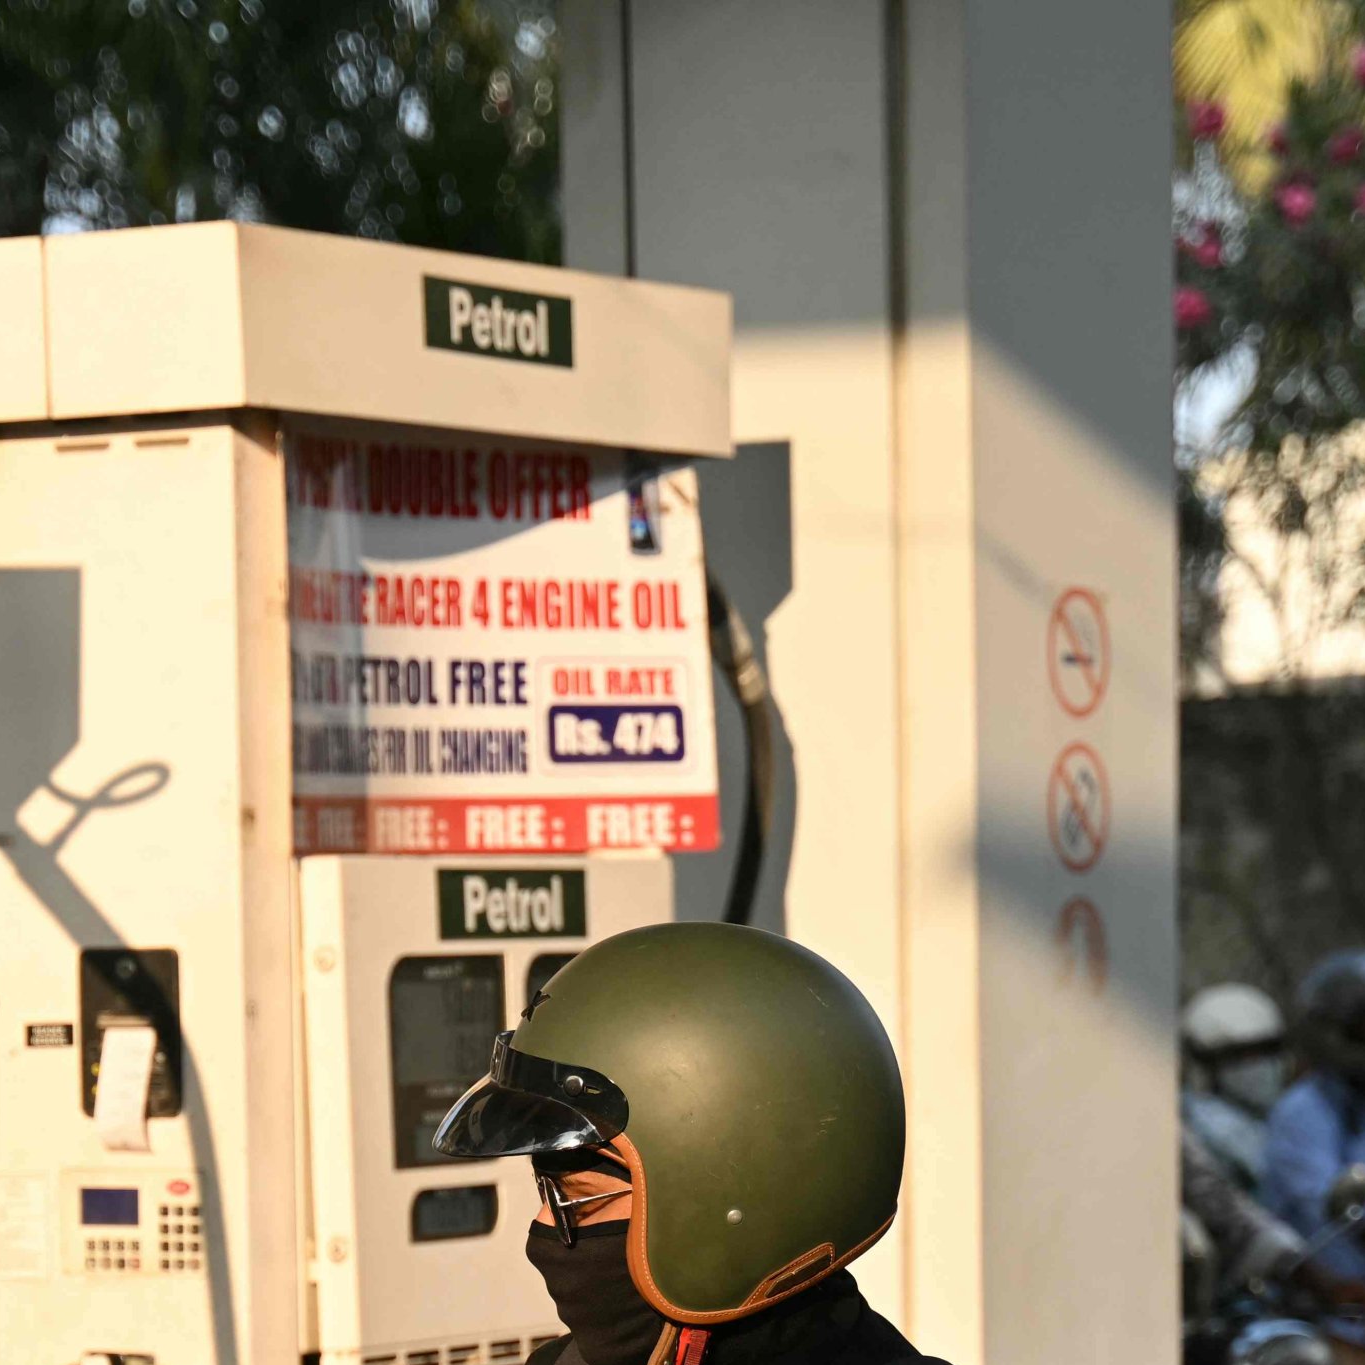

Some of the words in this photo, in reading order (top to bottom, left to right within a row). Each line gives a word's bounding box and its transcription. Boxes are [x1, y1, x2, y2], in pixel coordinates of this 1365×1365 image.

[448, 285, 550, 358] Petrol
[370, 448, 479, 518] DOUBLE
[487, 452, 592, 522] OFFER
[376, 574, 463, 628] RACER
[471, 576, 490, 627] 4
[500, 579, 623, 630] ENGINE
[632, 581, 686, 631] OIL
[344, 658, 437, 707] PETROL
[449, 660, 529, 707] FREE
[552, 668, 596, 698] OIL
[606, 668, 675, 698] RATE
[440, 728, 529, 775] CHANGING
[554, 711, 611, 756] Rs.
[462, 874, 564, 935] Petrol
